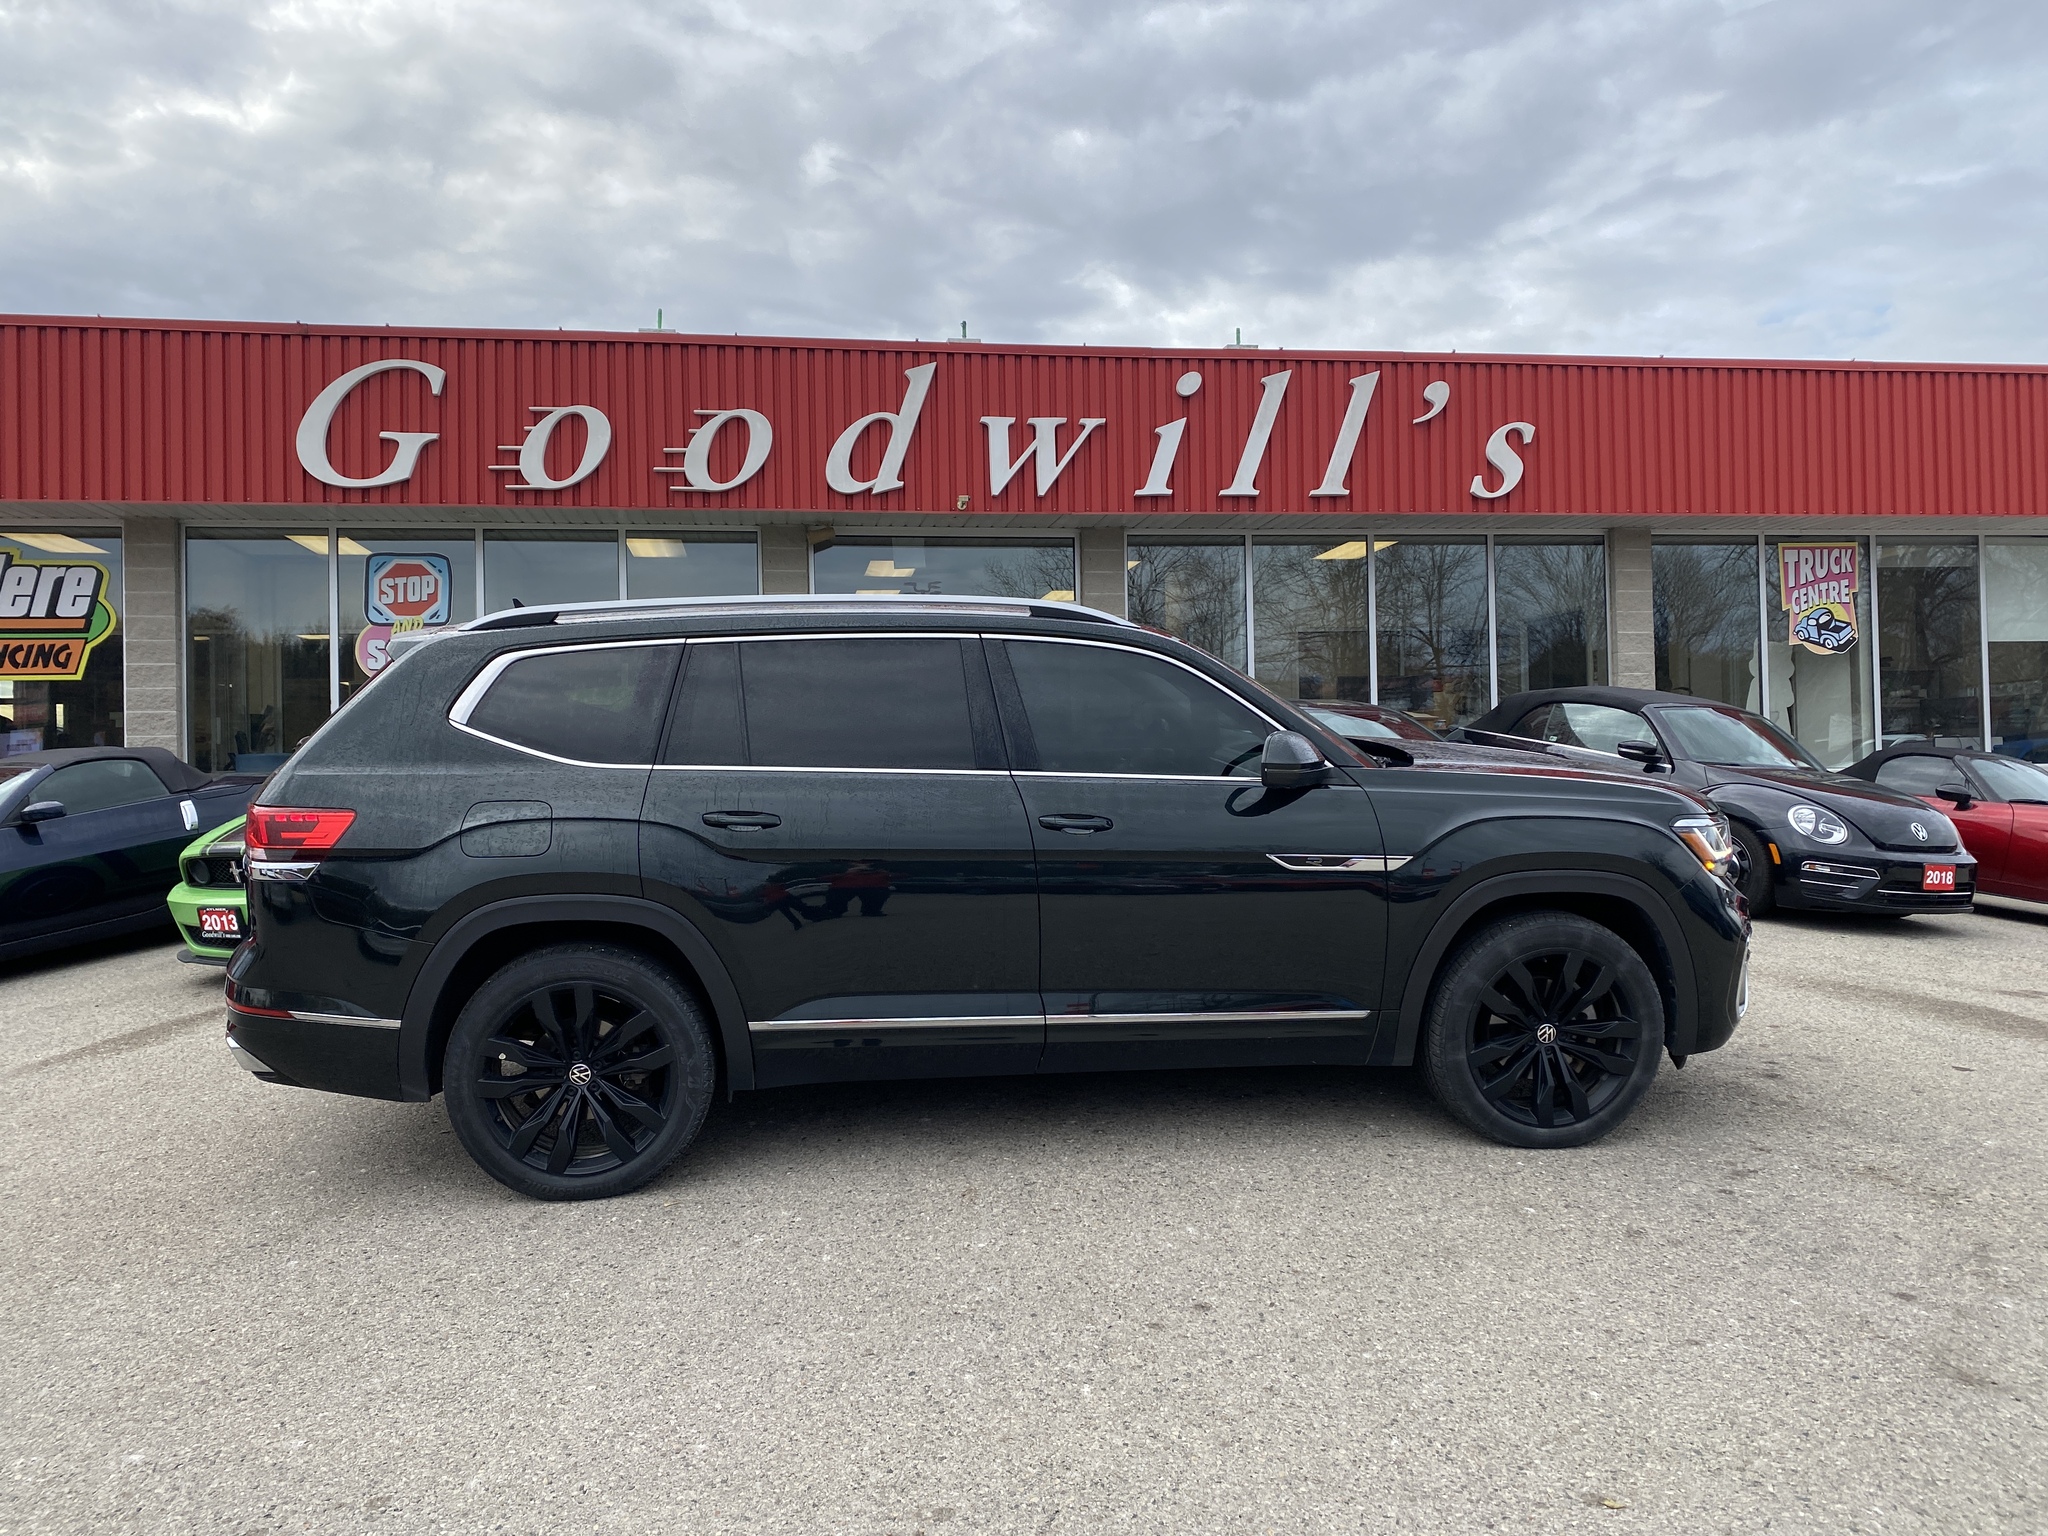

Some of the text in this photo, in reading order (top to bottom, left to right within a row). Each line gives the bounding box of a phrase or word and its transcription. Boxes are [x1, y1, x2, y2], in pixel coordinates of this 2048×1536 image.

[295, 358, 1536, 499] Goodwill's
[1783, 548, 1853, 588] TRUCK
[380, 575, 435, 605] STOP
[1791, 578, 1851, 615] CENTRE
[391, 616, 424, 635] AND
[1926, 870, 1953, 884] 2018
[202, 914, 239, 931] 2013
